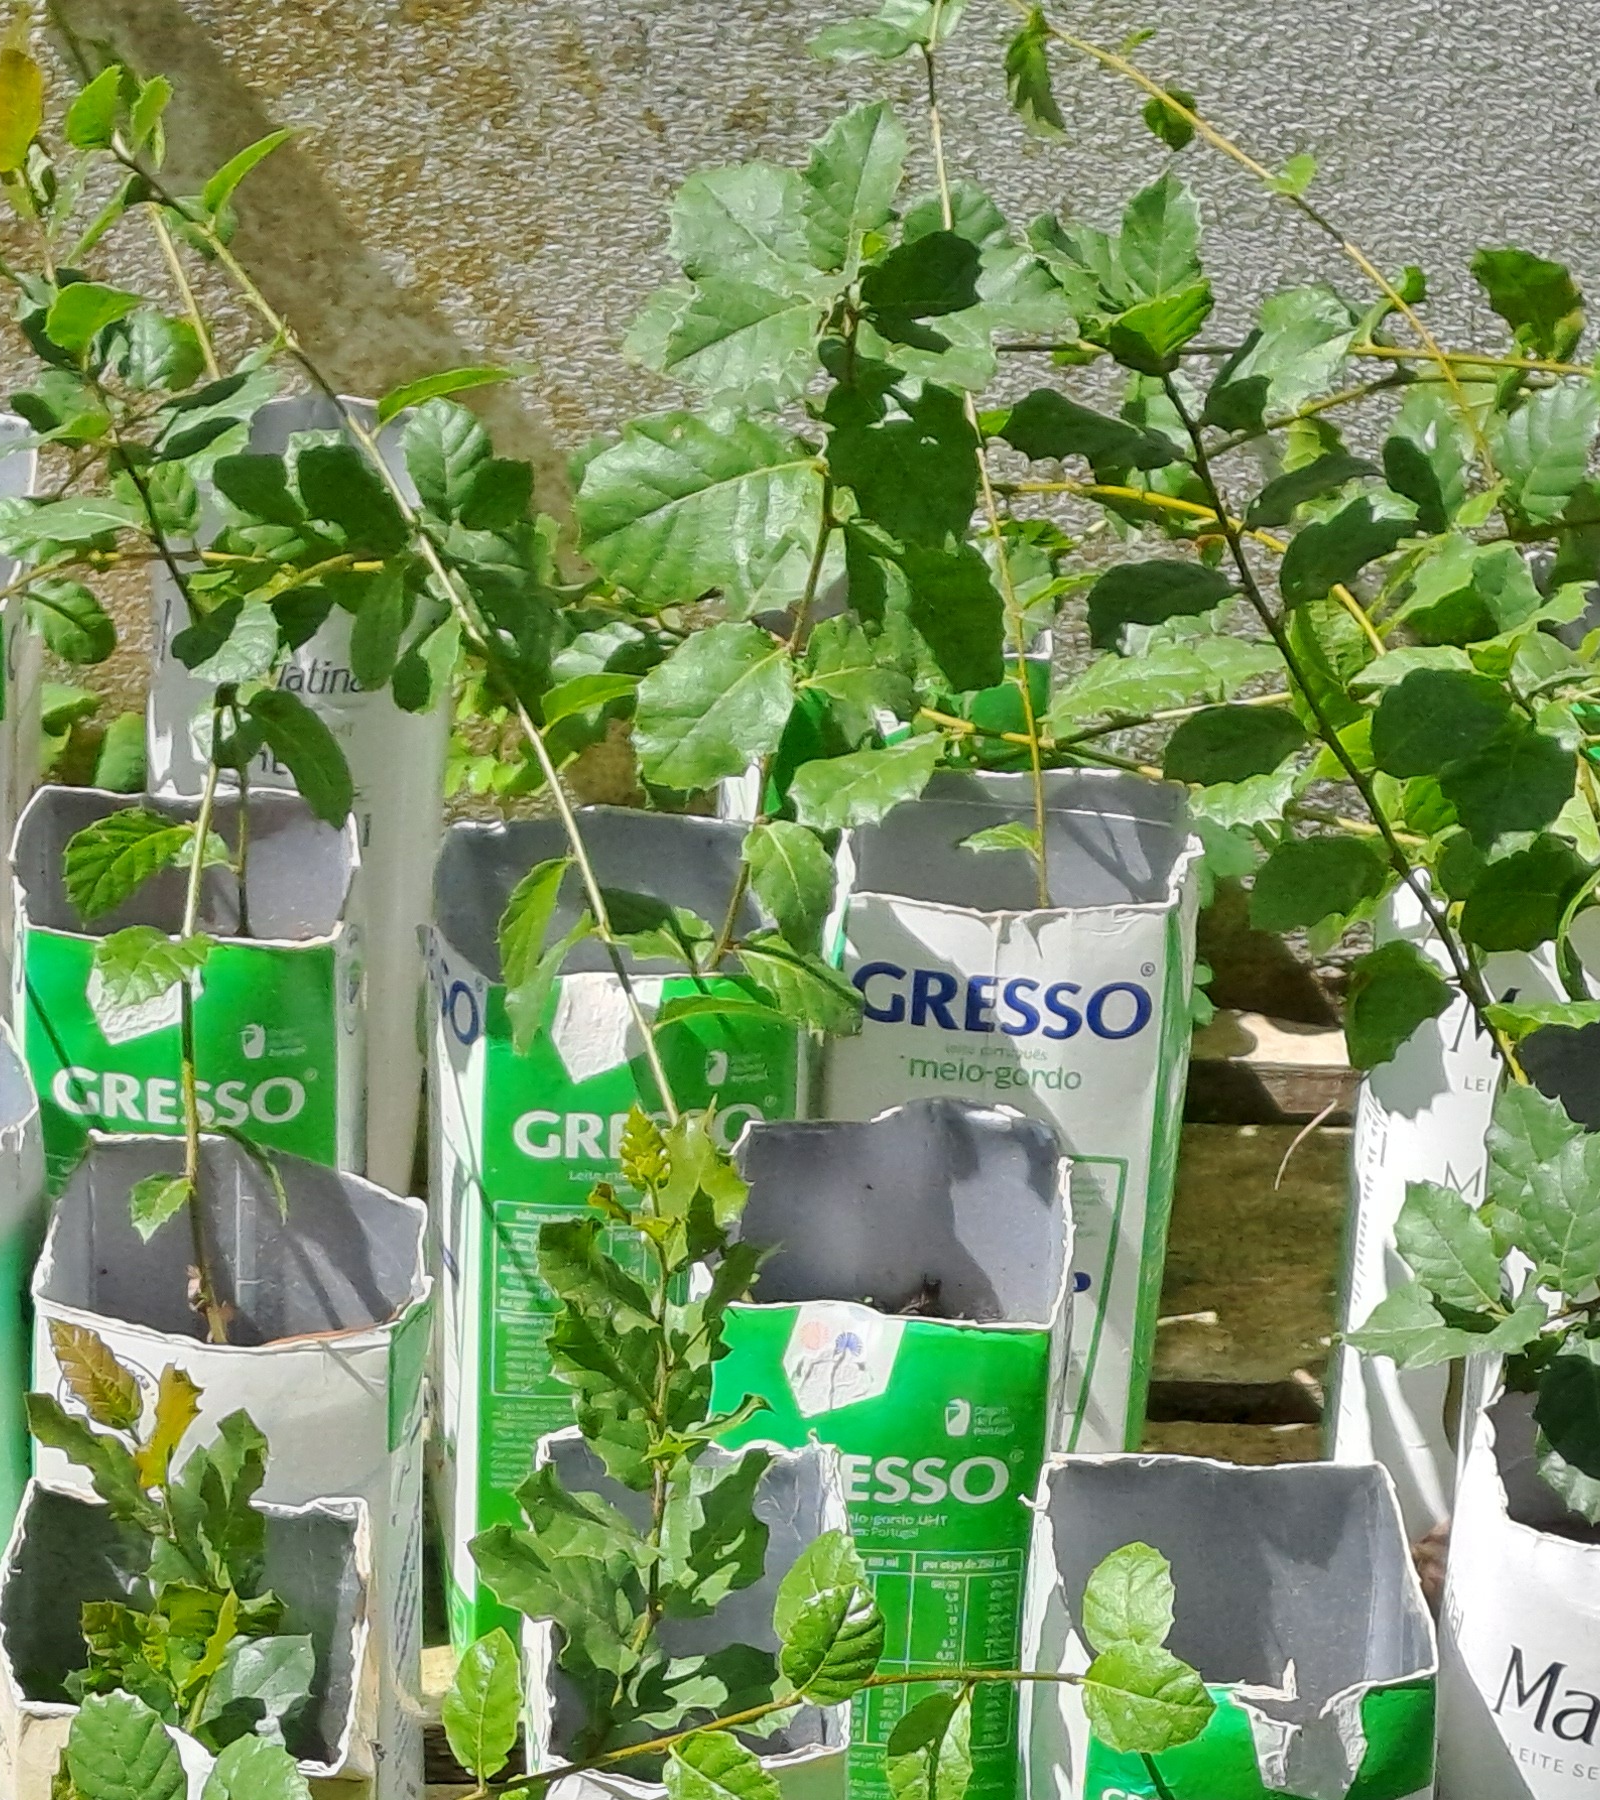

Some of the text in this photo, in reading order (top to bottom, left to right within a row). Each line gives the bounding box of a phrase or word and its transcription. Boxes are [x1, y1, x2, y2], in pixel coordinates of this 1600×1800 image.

[852, 961, 1153, 1041] GRESSO
[52, 1066, 307, 1128] GRESSO
[908, 1055, 1082, 1092] meio-gordo
[841, 1455, 1011, 1506] ESSO
